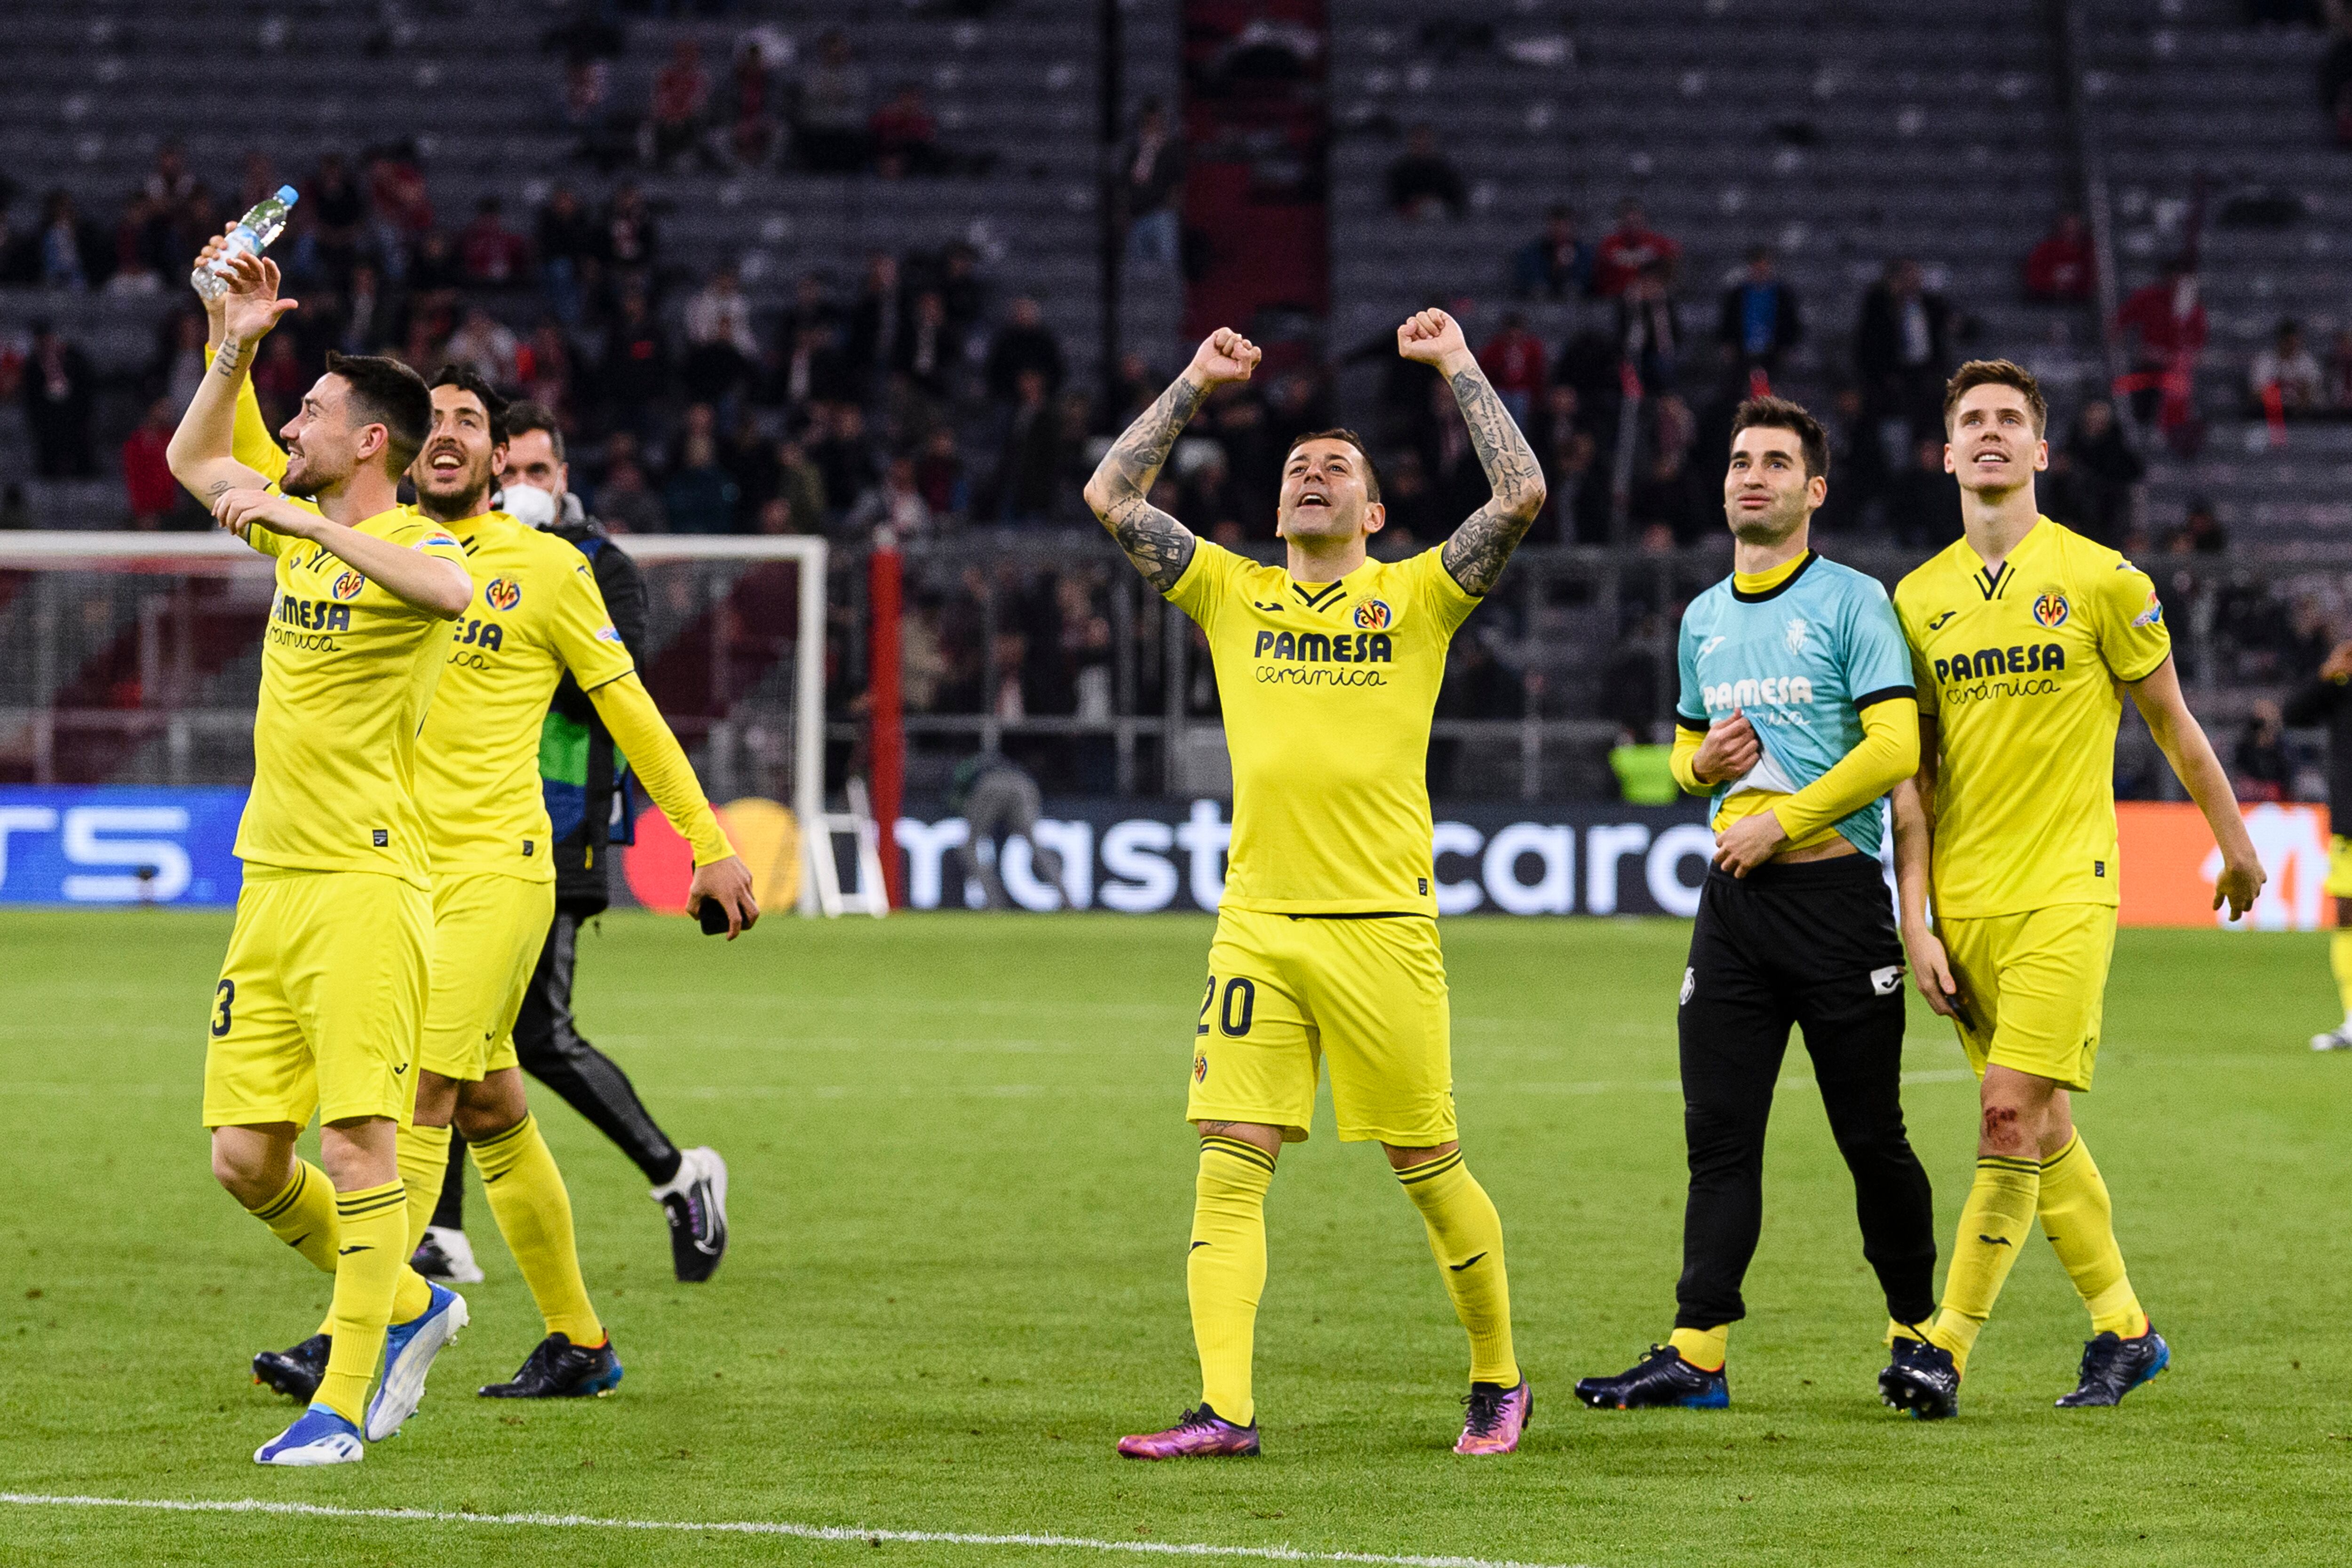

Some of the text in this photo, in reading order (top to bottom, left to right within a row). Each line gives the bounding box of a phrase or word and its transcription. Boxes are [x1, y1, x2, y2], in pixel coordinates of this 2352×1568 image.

[1255, 630, 1391, 662] PAMESA
[1256, 665, 1387, 686] cerámica
[1934, 644, 2065, 685] PAMESA
[1703, 676, 1812, 714] PAMESA
[1947, 678, 2061, 704] cerámica
[1196, 975, 1255, 1038] 20
